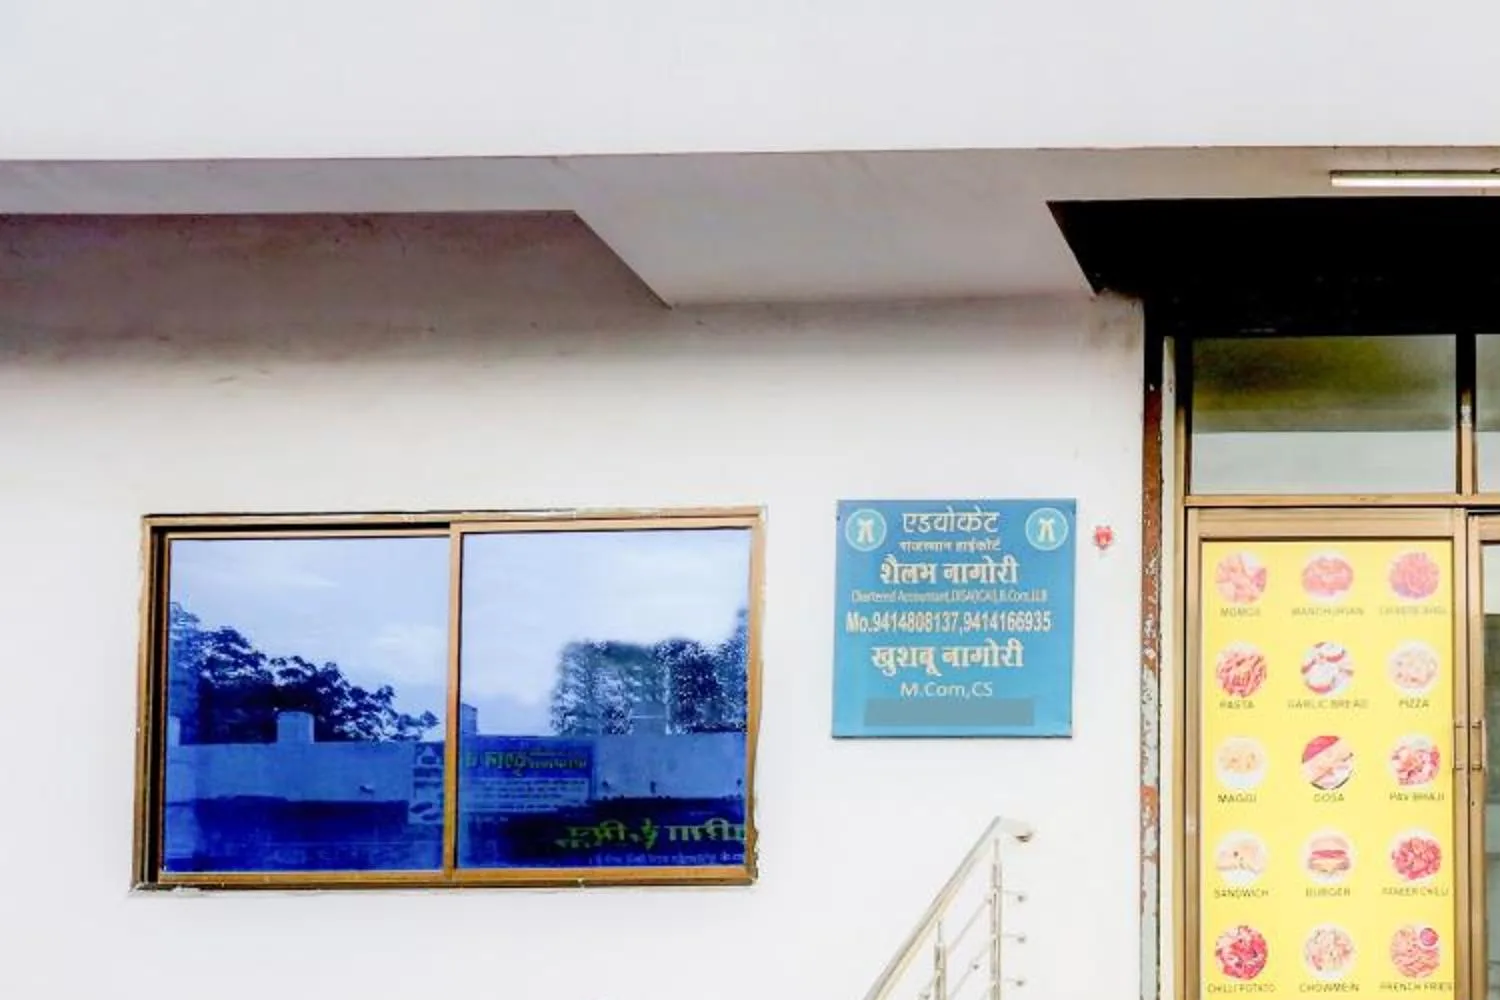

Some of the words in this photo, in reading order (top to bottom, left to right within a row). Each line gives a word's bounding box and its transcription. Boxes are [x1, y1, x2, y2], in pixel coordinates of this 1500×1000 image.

[943, 555, 1020, 585] नागोरी
[871, 647, 942, 677] खुशबू
[942, 638, 1025, 668] नागोरी
[1218, 699, 1255, 709] PASTA
[1287, 699, 1328, 709] GARLIC
[1329, 699, 1370, 709] BREAD
[1397, 698, 1430, 709] PIZZA
[1214, 888, 1269, 898] SANDWICH
[1305, 887, 1351, 897] BURGER
